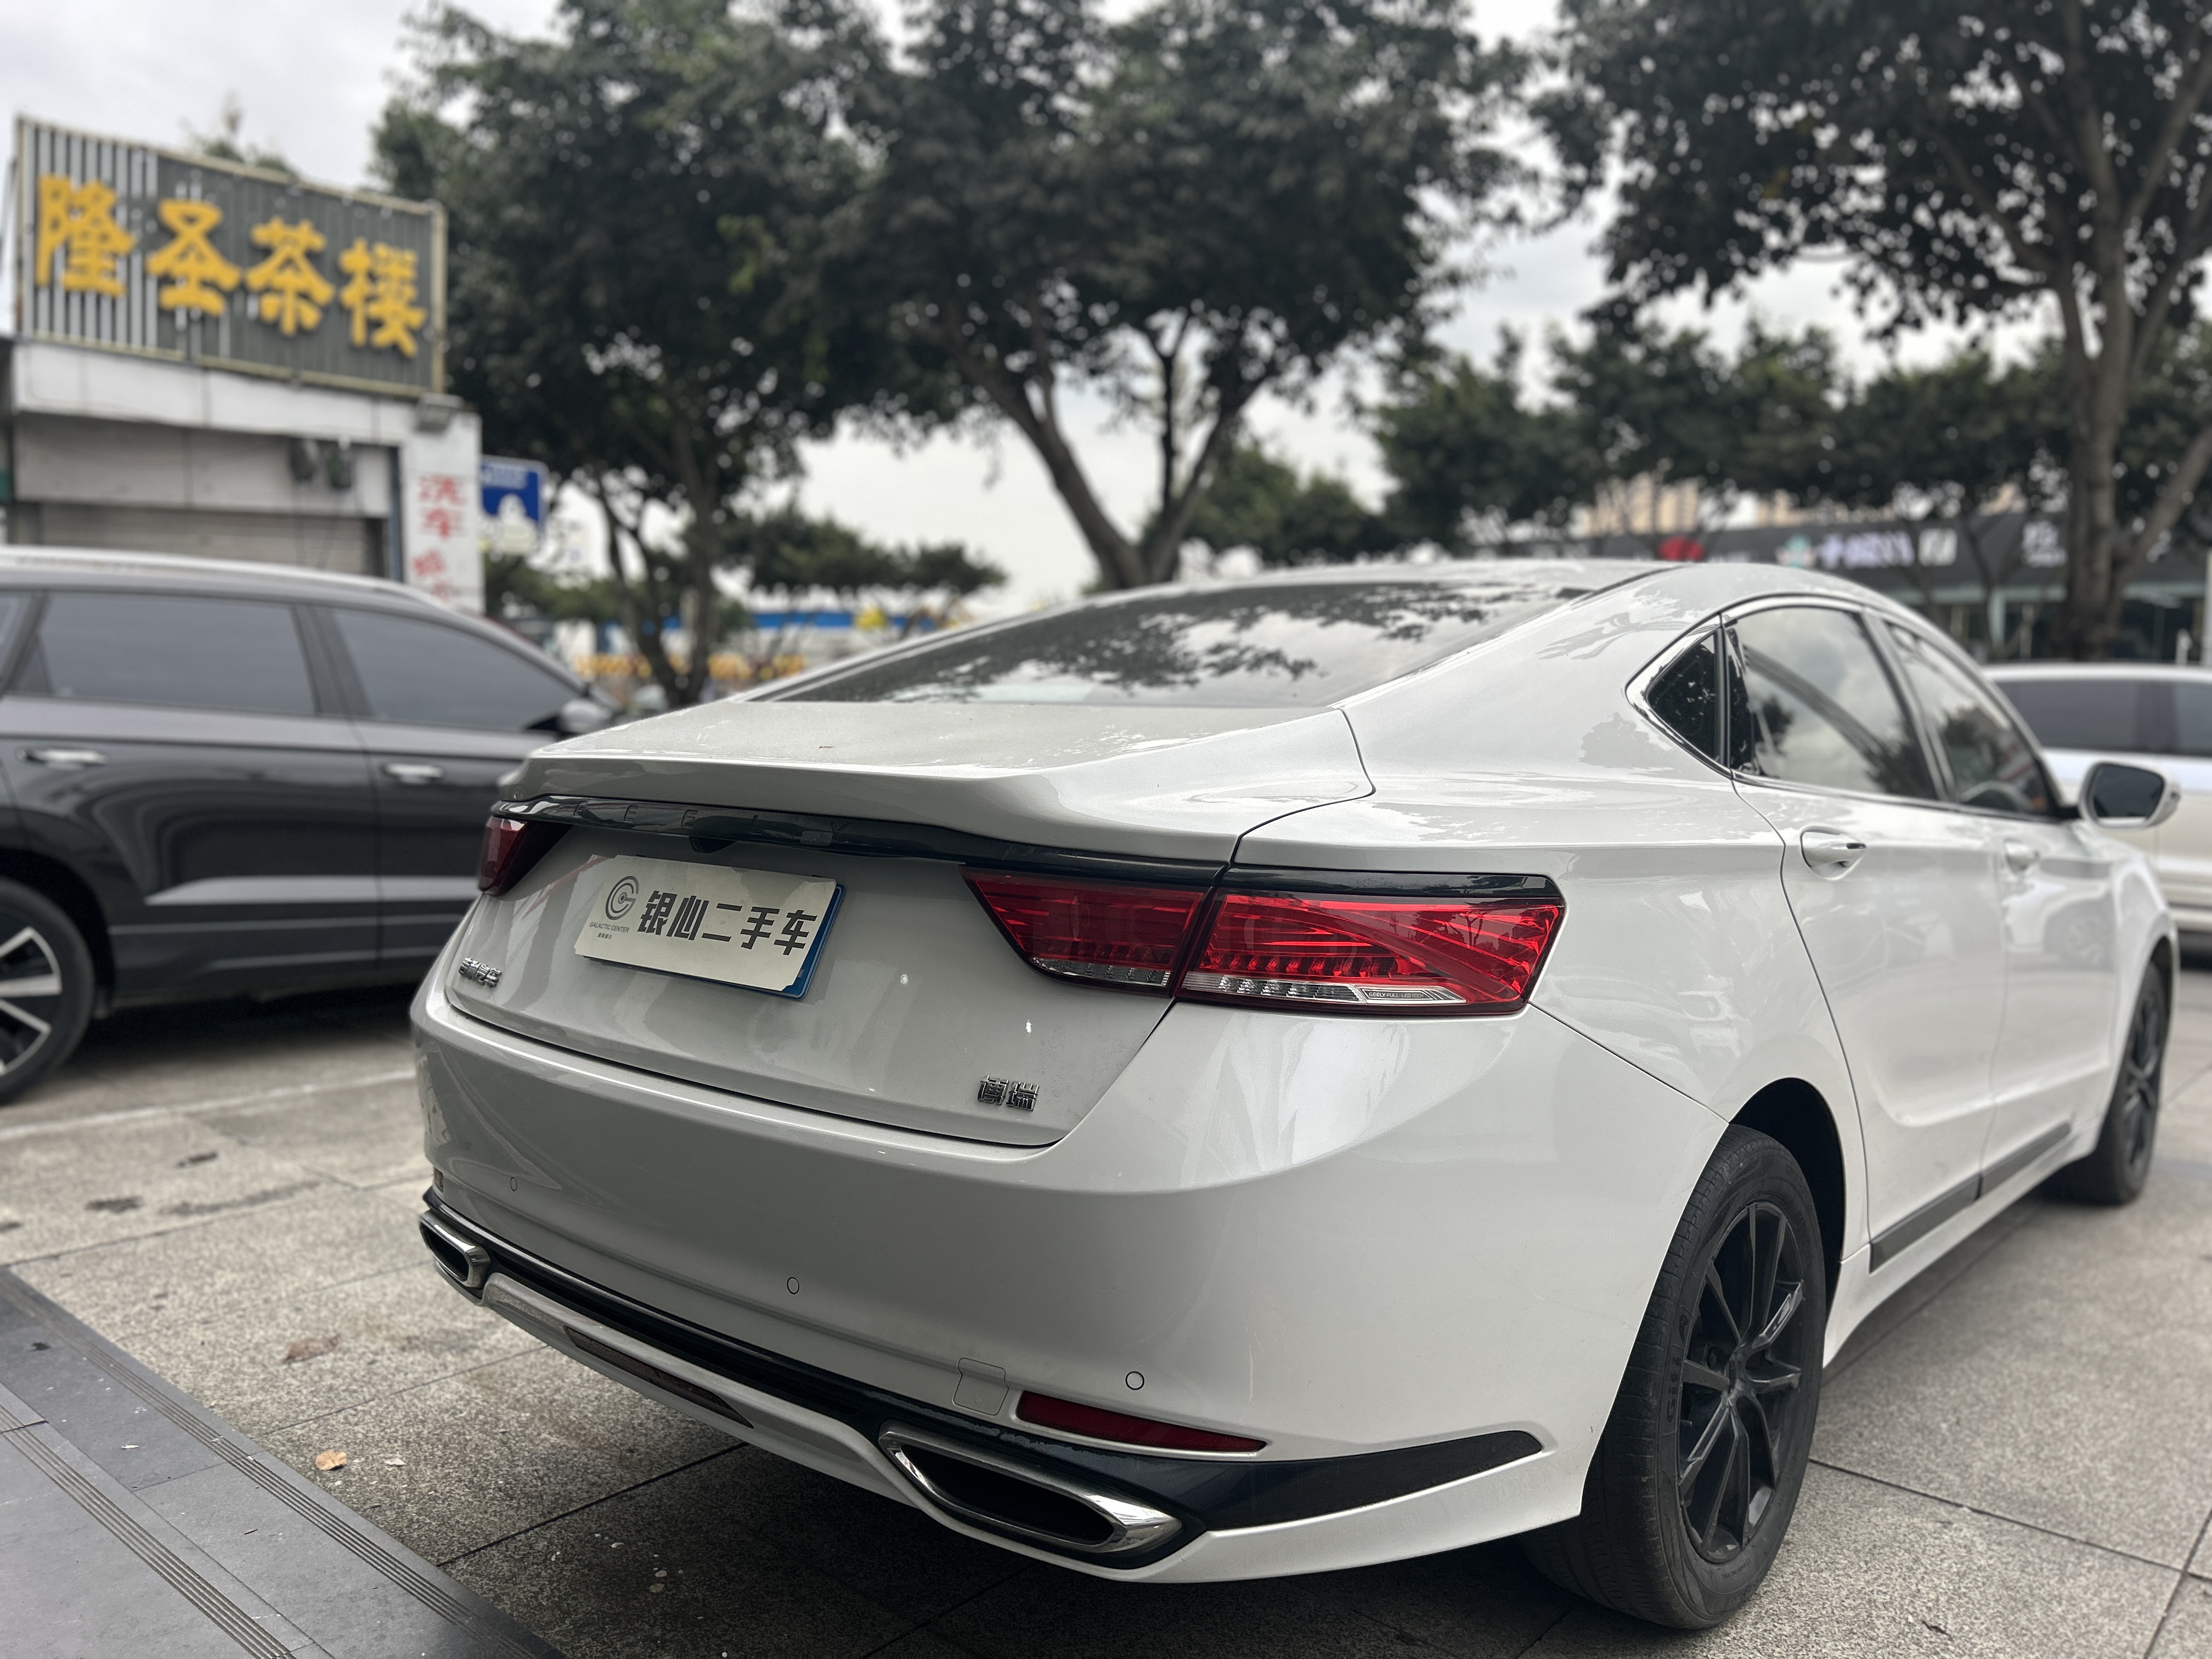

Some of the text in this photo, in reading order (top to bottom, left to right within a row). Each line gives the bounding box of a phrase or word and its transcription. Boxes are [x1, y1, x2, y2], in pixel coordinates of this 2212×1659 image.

[589, 922, 611, 930] GALACTIC
[637, 890, 818, 956] 银心二手车
[978, 1075, 1040, 1112] 博瑞
